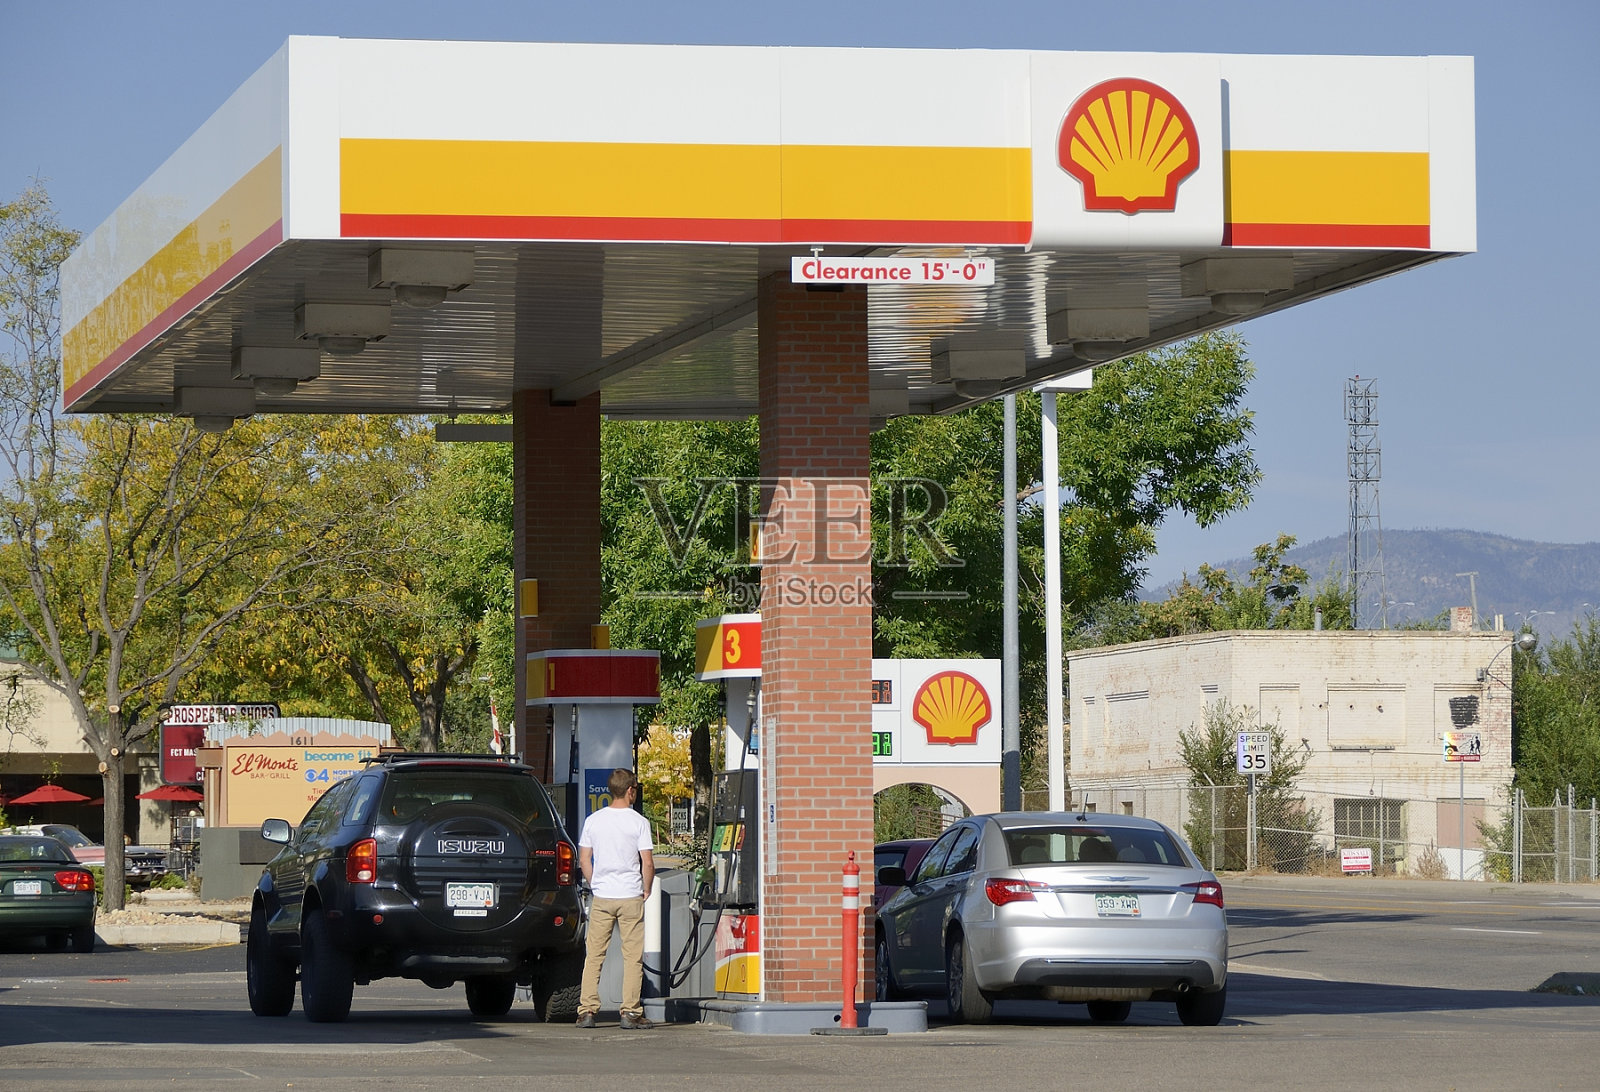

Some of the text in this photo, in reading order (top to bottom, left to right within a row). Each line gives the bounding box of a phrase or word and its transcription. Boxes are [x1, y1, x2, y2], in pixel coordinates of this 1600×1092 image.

[801, 260, 911, 280] Clearance
[725, 629, 742, 664] 3
[549, 663, 556, 691] 1
[290, 736, 314, 746] 1611
[1240, 735, 1268, 743] SPEED
[170, 748, 182, 757] FCT
[304, 750, 373, 761] become fit
[230, 753, 299, 776] El Monte
[1242, 754, 1266, 769] 35
[317, 768, 330, 783] 4
[438, 839, 504, 855] ISUZU
